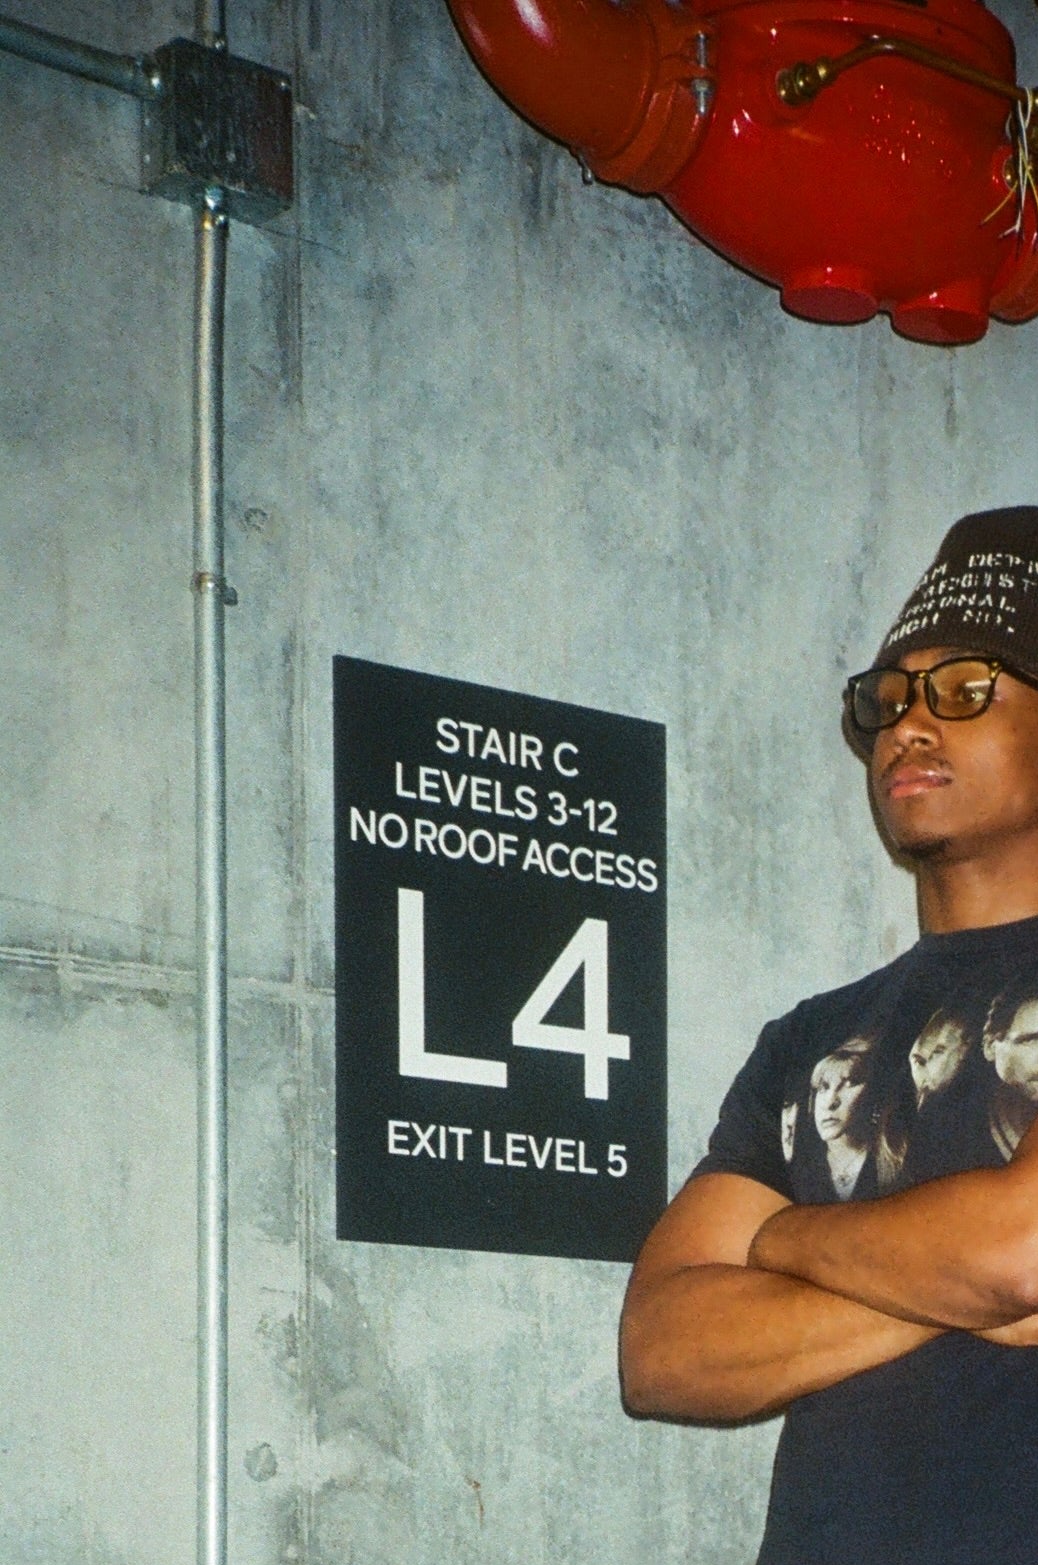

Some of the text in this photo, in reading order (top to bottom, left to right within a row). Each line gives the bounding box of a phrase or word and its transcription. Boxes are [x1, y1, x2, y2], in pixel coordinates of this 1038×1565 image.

[436, 716, 579, 778] STAIR C
[395, 761, 618, 836] LEVELS 3-12
[350, 806, 659, 892] NO ROOF ACCESS
[398, 886, 631, 1101] L4
[387, 1119, 628, 1178] EXIT LEVEL 5
